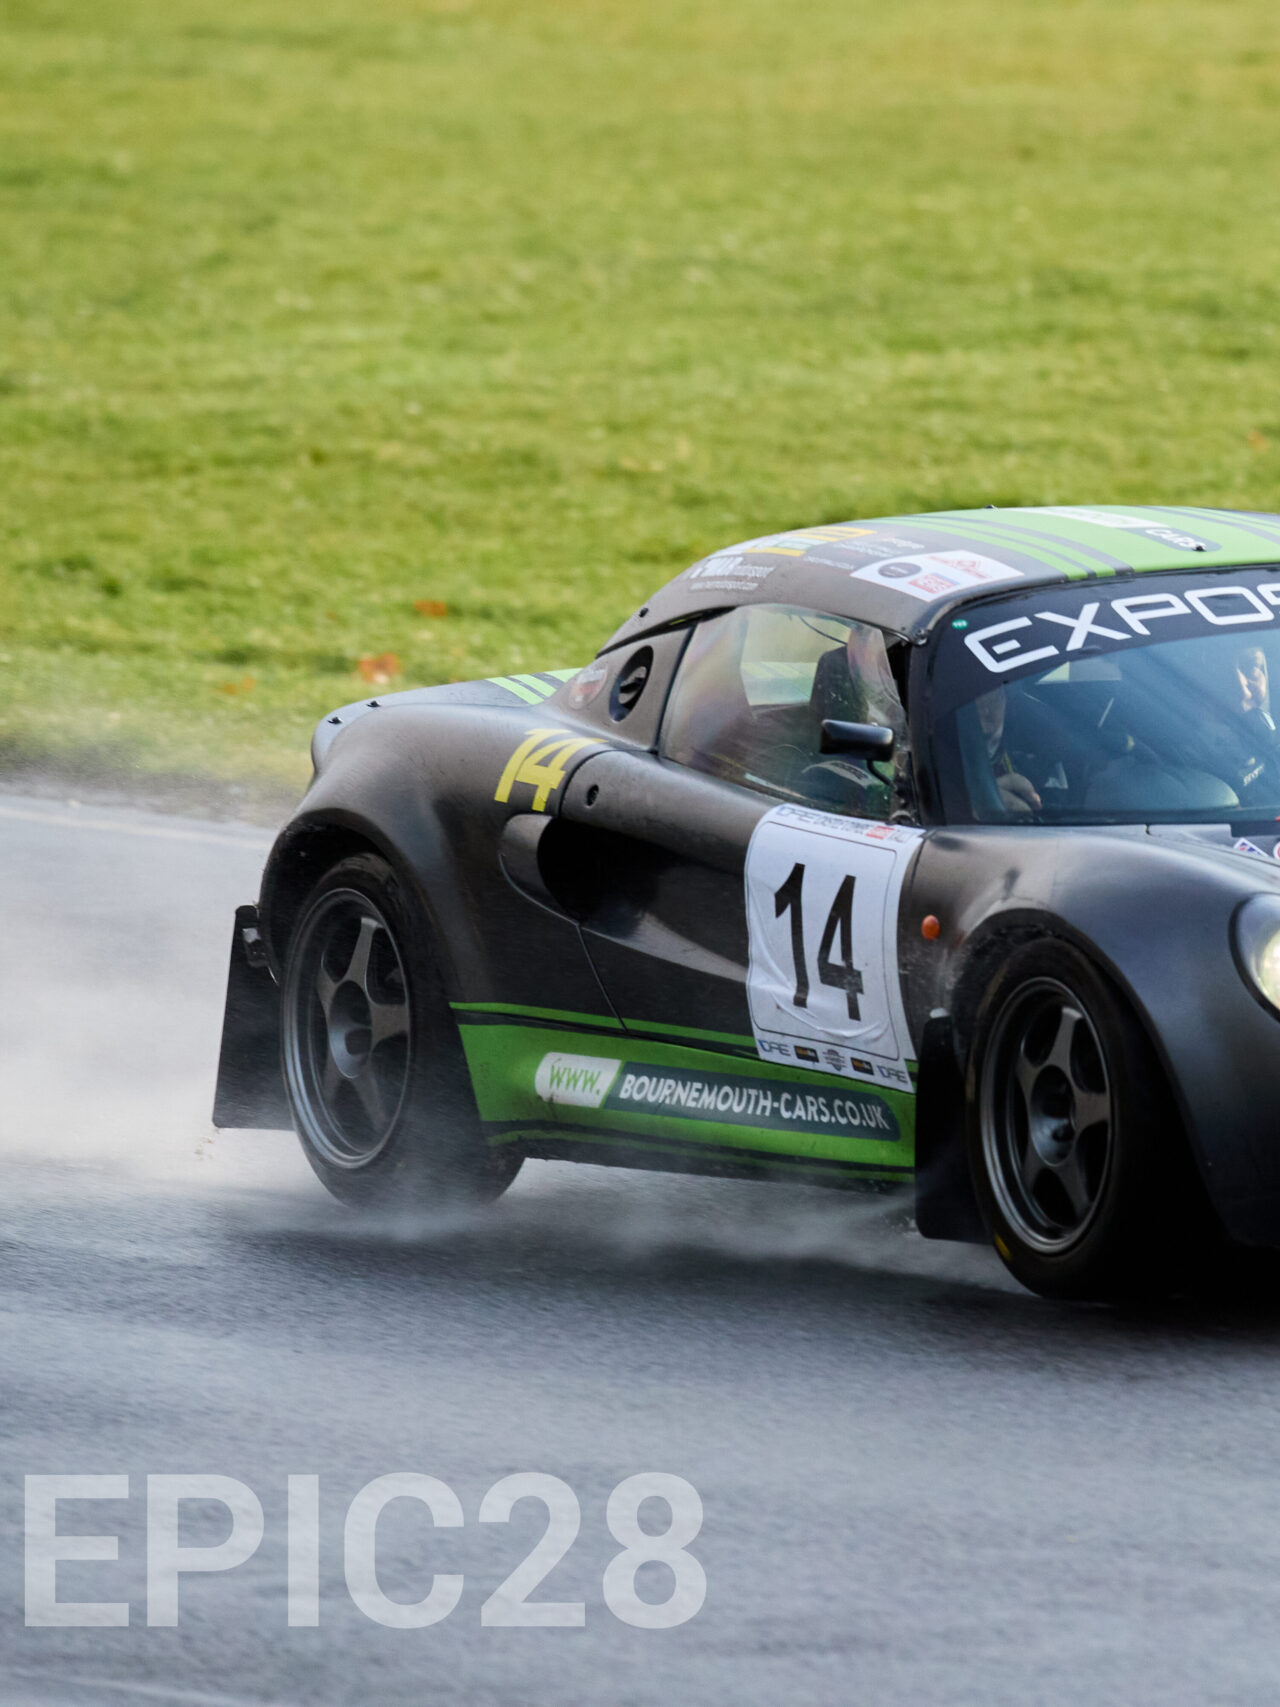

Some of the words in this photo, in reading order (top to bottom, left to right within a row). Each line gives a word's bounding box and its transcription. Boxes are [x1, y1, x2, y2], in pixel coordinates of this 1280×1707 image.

[494, 728, 608, 812] 14
[774, 862, 864, 1022] 14
[619, 1073, 891, 1131] BOURNEMOUTH-CARS.CO.UK
